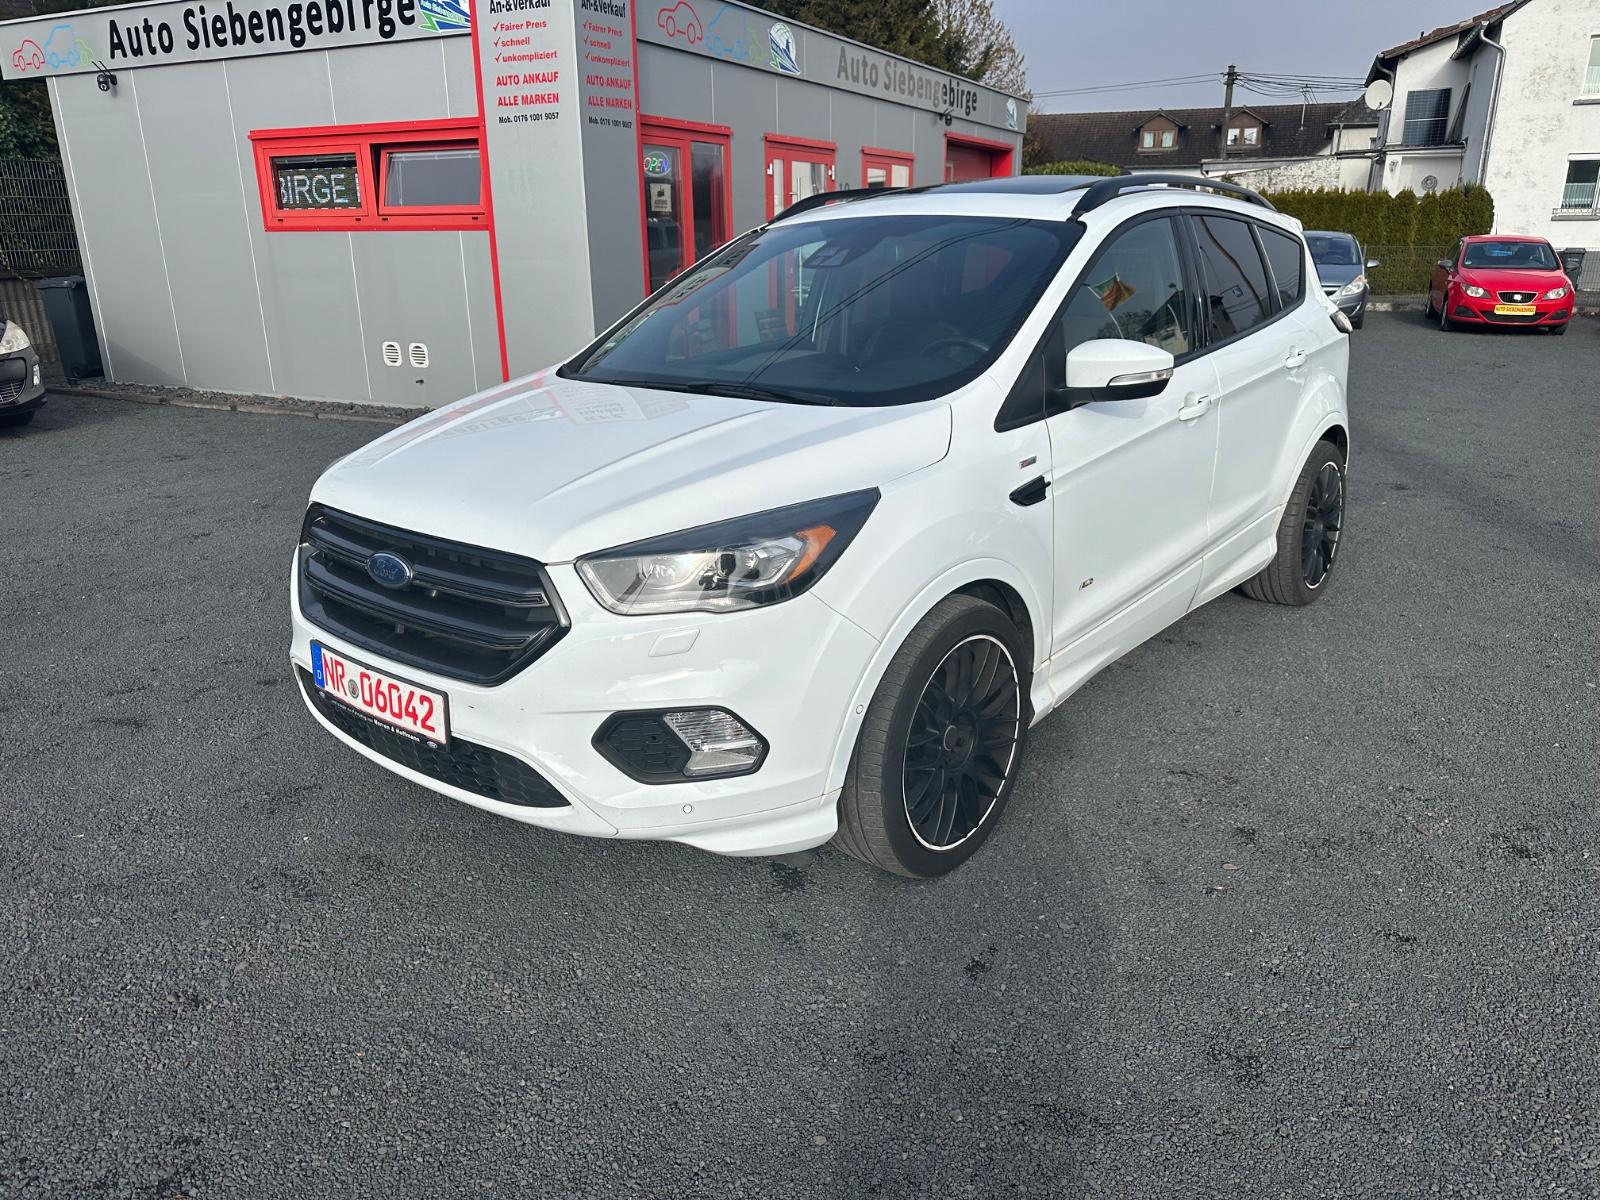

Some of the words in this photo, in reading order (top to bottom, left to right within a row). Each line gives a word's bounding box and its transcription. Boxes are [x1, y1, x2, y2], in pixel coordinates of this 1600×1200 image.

[109, 18, 174, 60] Auto
[183, 0, 416, 48] Siebengebirge
[500, 23, 524, 31] Fairer
[526, 20, 547, 29] Preis
[501, 37, 531, 47] schnell
[502, 51, 558, 63] unkompliziert
[496, 74, 520, 87] AUTO
[523, 71, 559, 84] ANKAUF
[836, 46, 879, 88] Auto
[883, 59, 978, 116] Siebengebirge
[498, 96, 519, 107] ALLE
[522, 93, 559, 105] MARKEN
[588, 95, 605, 107] ALLE
[605, 97, 632, 110] MARKEN
[644, 157, 669, 173] OPEN
[317, 670, 322, 680] D
[323, 653, 347, 696] NR
[360, 671, 436, 733] 06042
